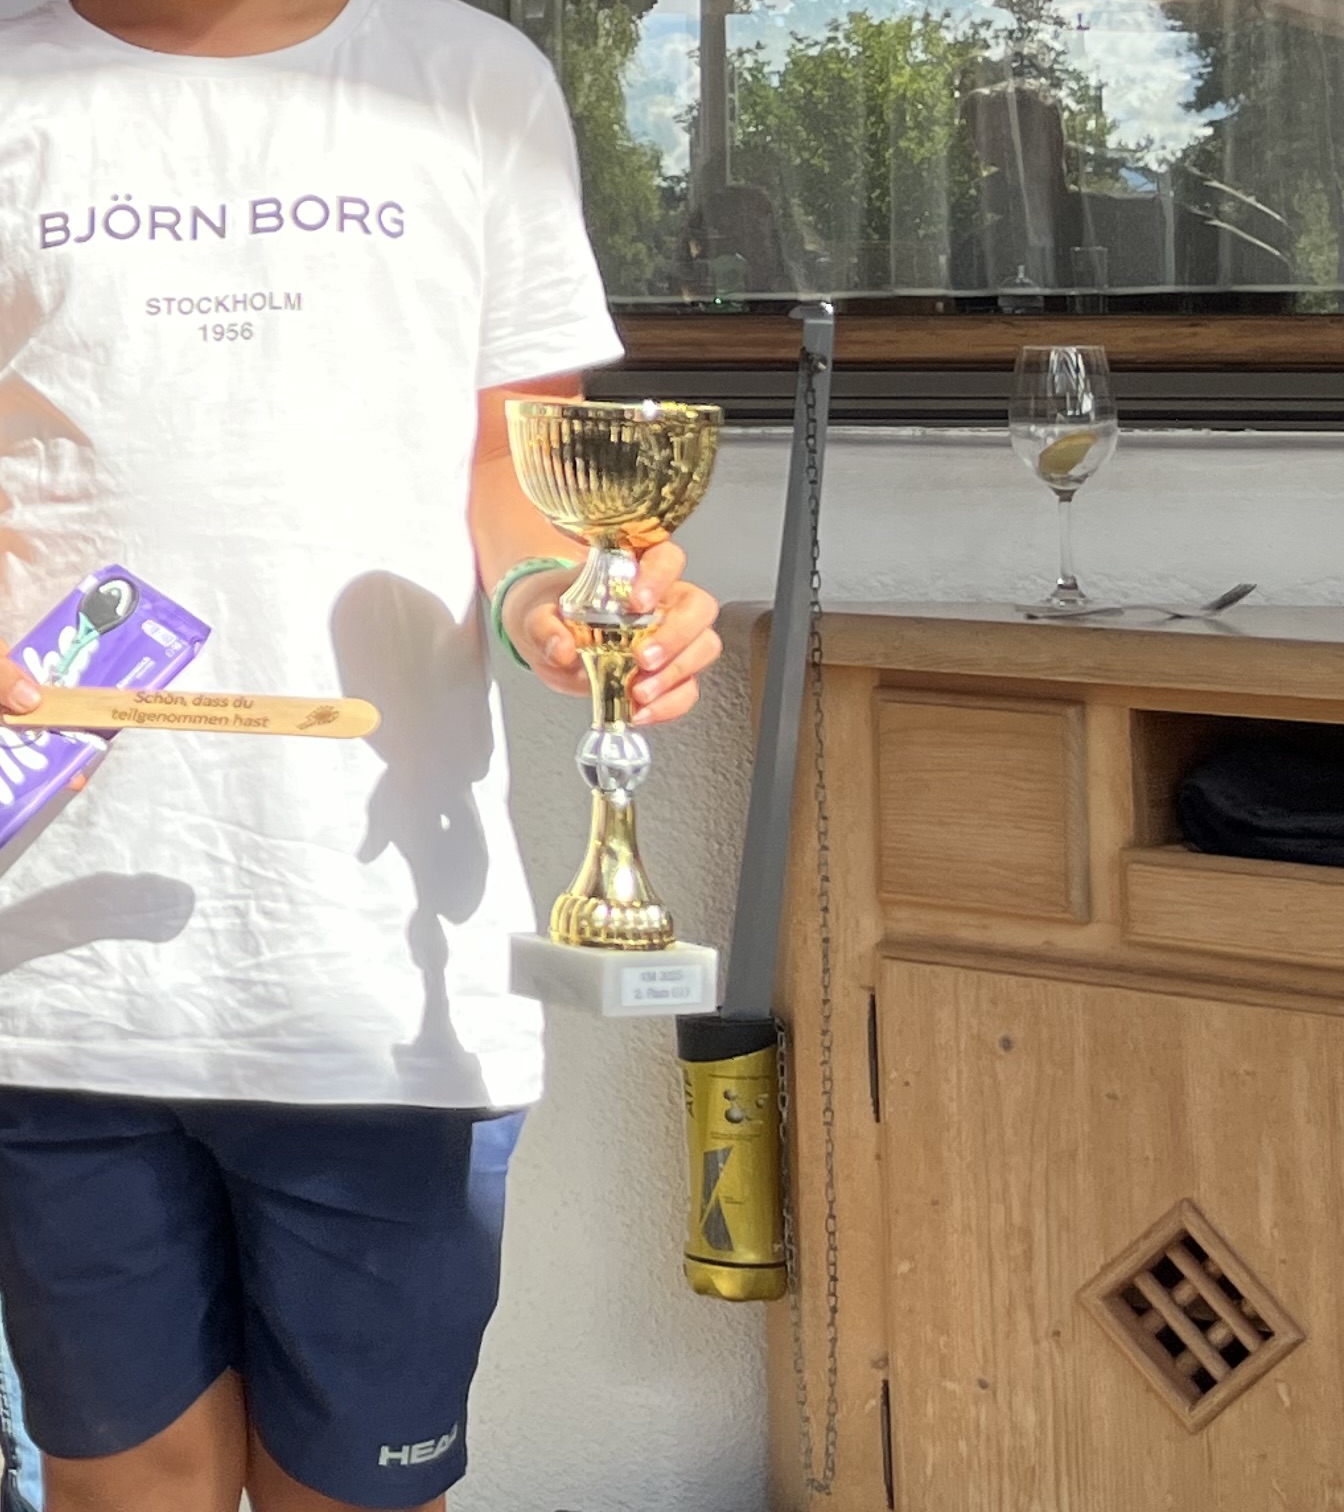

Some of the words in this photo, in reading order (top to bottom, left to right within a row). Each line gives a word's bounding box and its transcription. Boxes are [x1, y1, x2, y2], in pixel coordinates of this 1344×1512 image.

[39, 193, 226, 250] BJÖRN
[248, 194, 405, 239] BORG
[145, 291, 303, 316] STOCKHOLM
[198, 321, 254, 342] 1956
[191, 694, 229, 707] dass
[232, 696, 254, 709] du
[232, 713, 270, 729] hast
[378, 1421, 458, 1467] HEA
